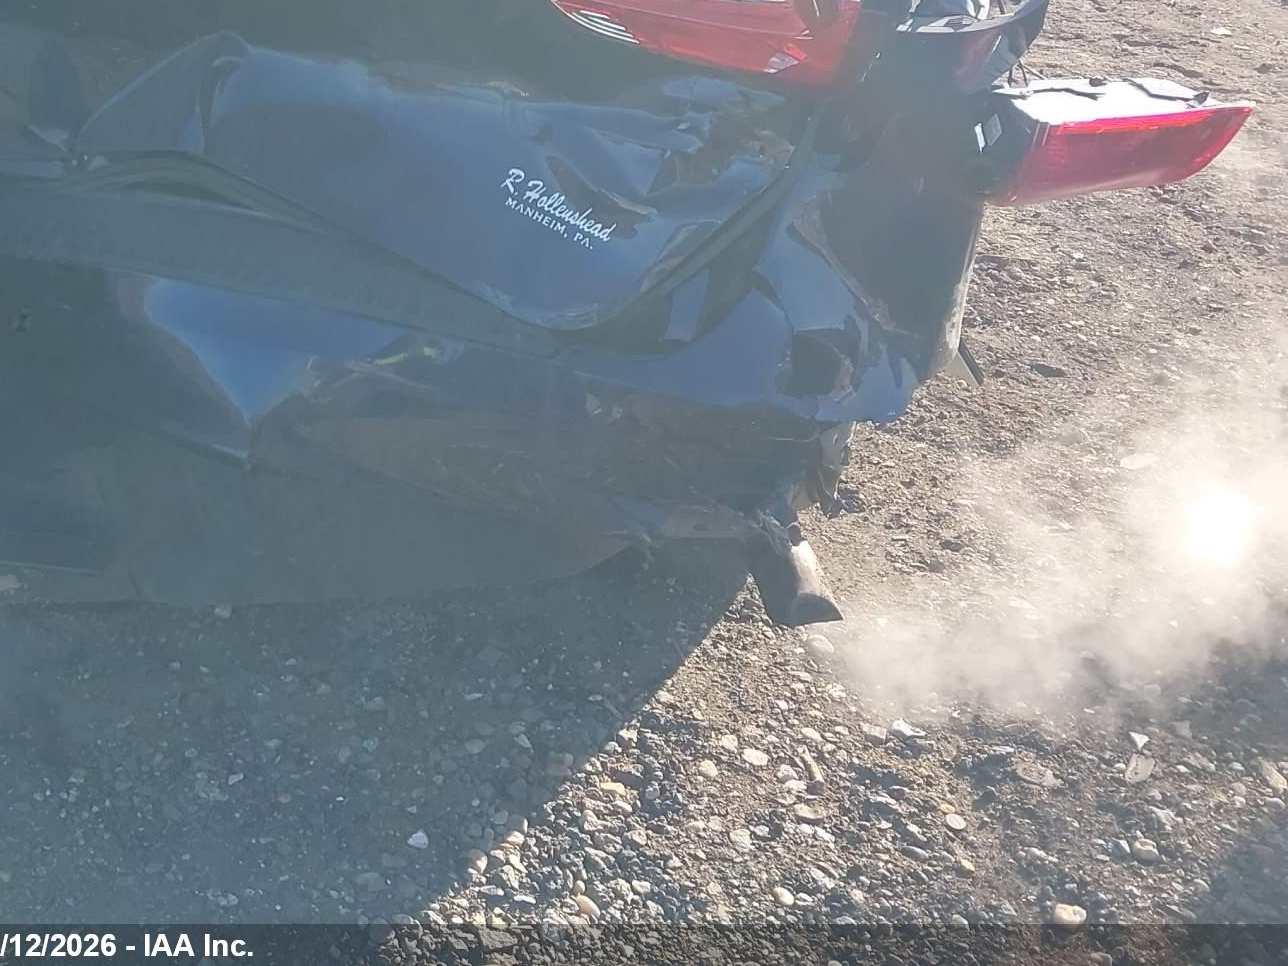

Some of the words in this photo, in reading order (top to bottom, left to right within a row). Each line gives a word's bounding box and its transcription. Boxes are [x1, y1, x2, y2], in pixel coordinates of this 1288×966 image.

[500, 168, 525, 195] R.
[505, 197, 568, 238] MANHEIM,
[573, 233, 594, 250] PA.
